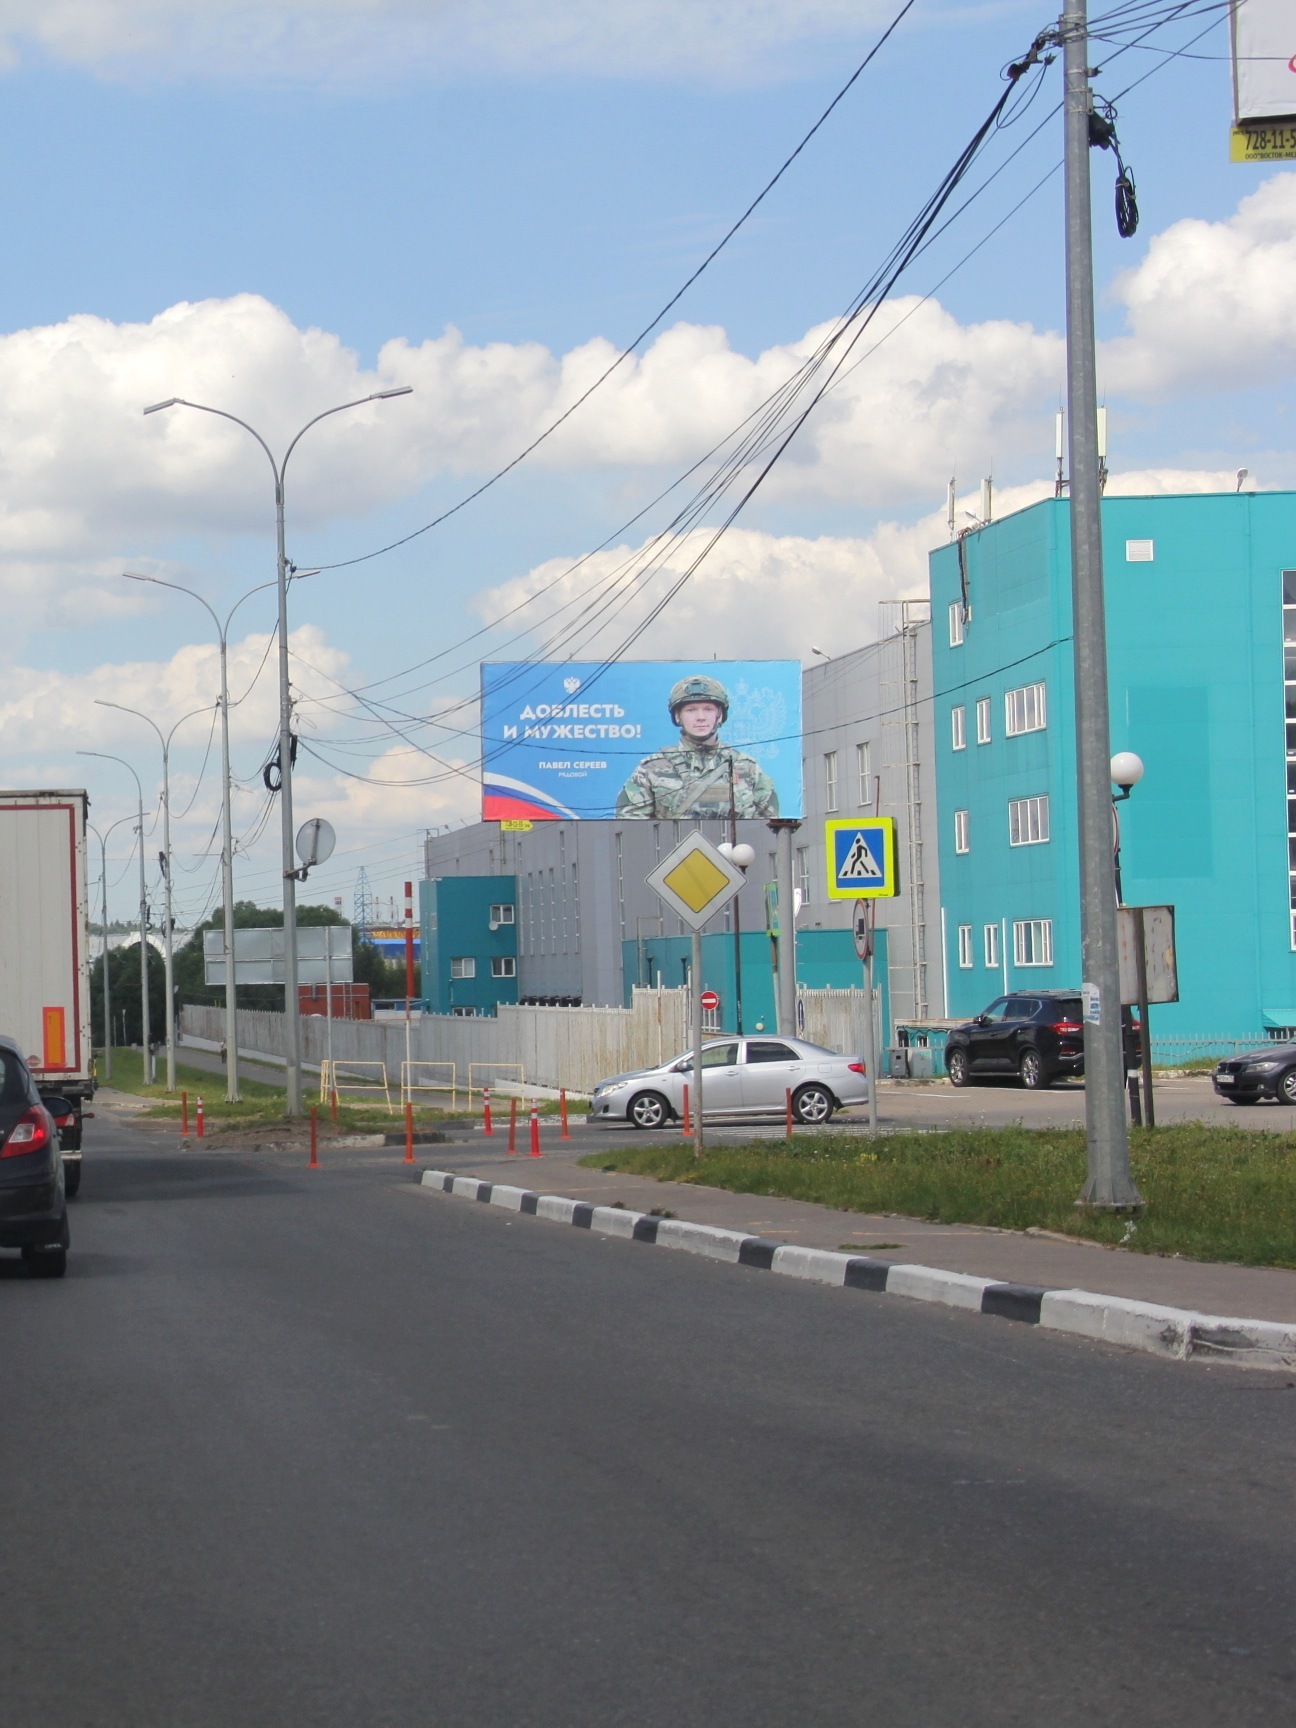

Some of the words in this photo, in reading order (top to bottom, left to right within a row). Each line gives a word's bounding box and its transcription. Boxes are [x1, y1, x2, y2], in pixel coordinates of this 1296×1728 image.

[519, 703, 625, 720] ДОБЛЕСТЬ
[503, 724, 518, 739] И
[524, 724, 641, 739] МУЖЕСТВО!
[538, 761, 571, 769] ПАВЕЛ
